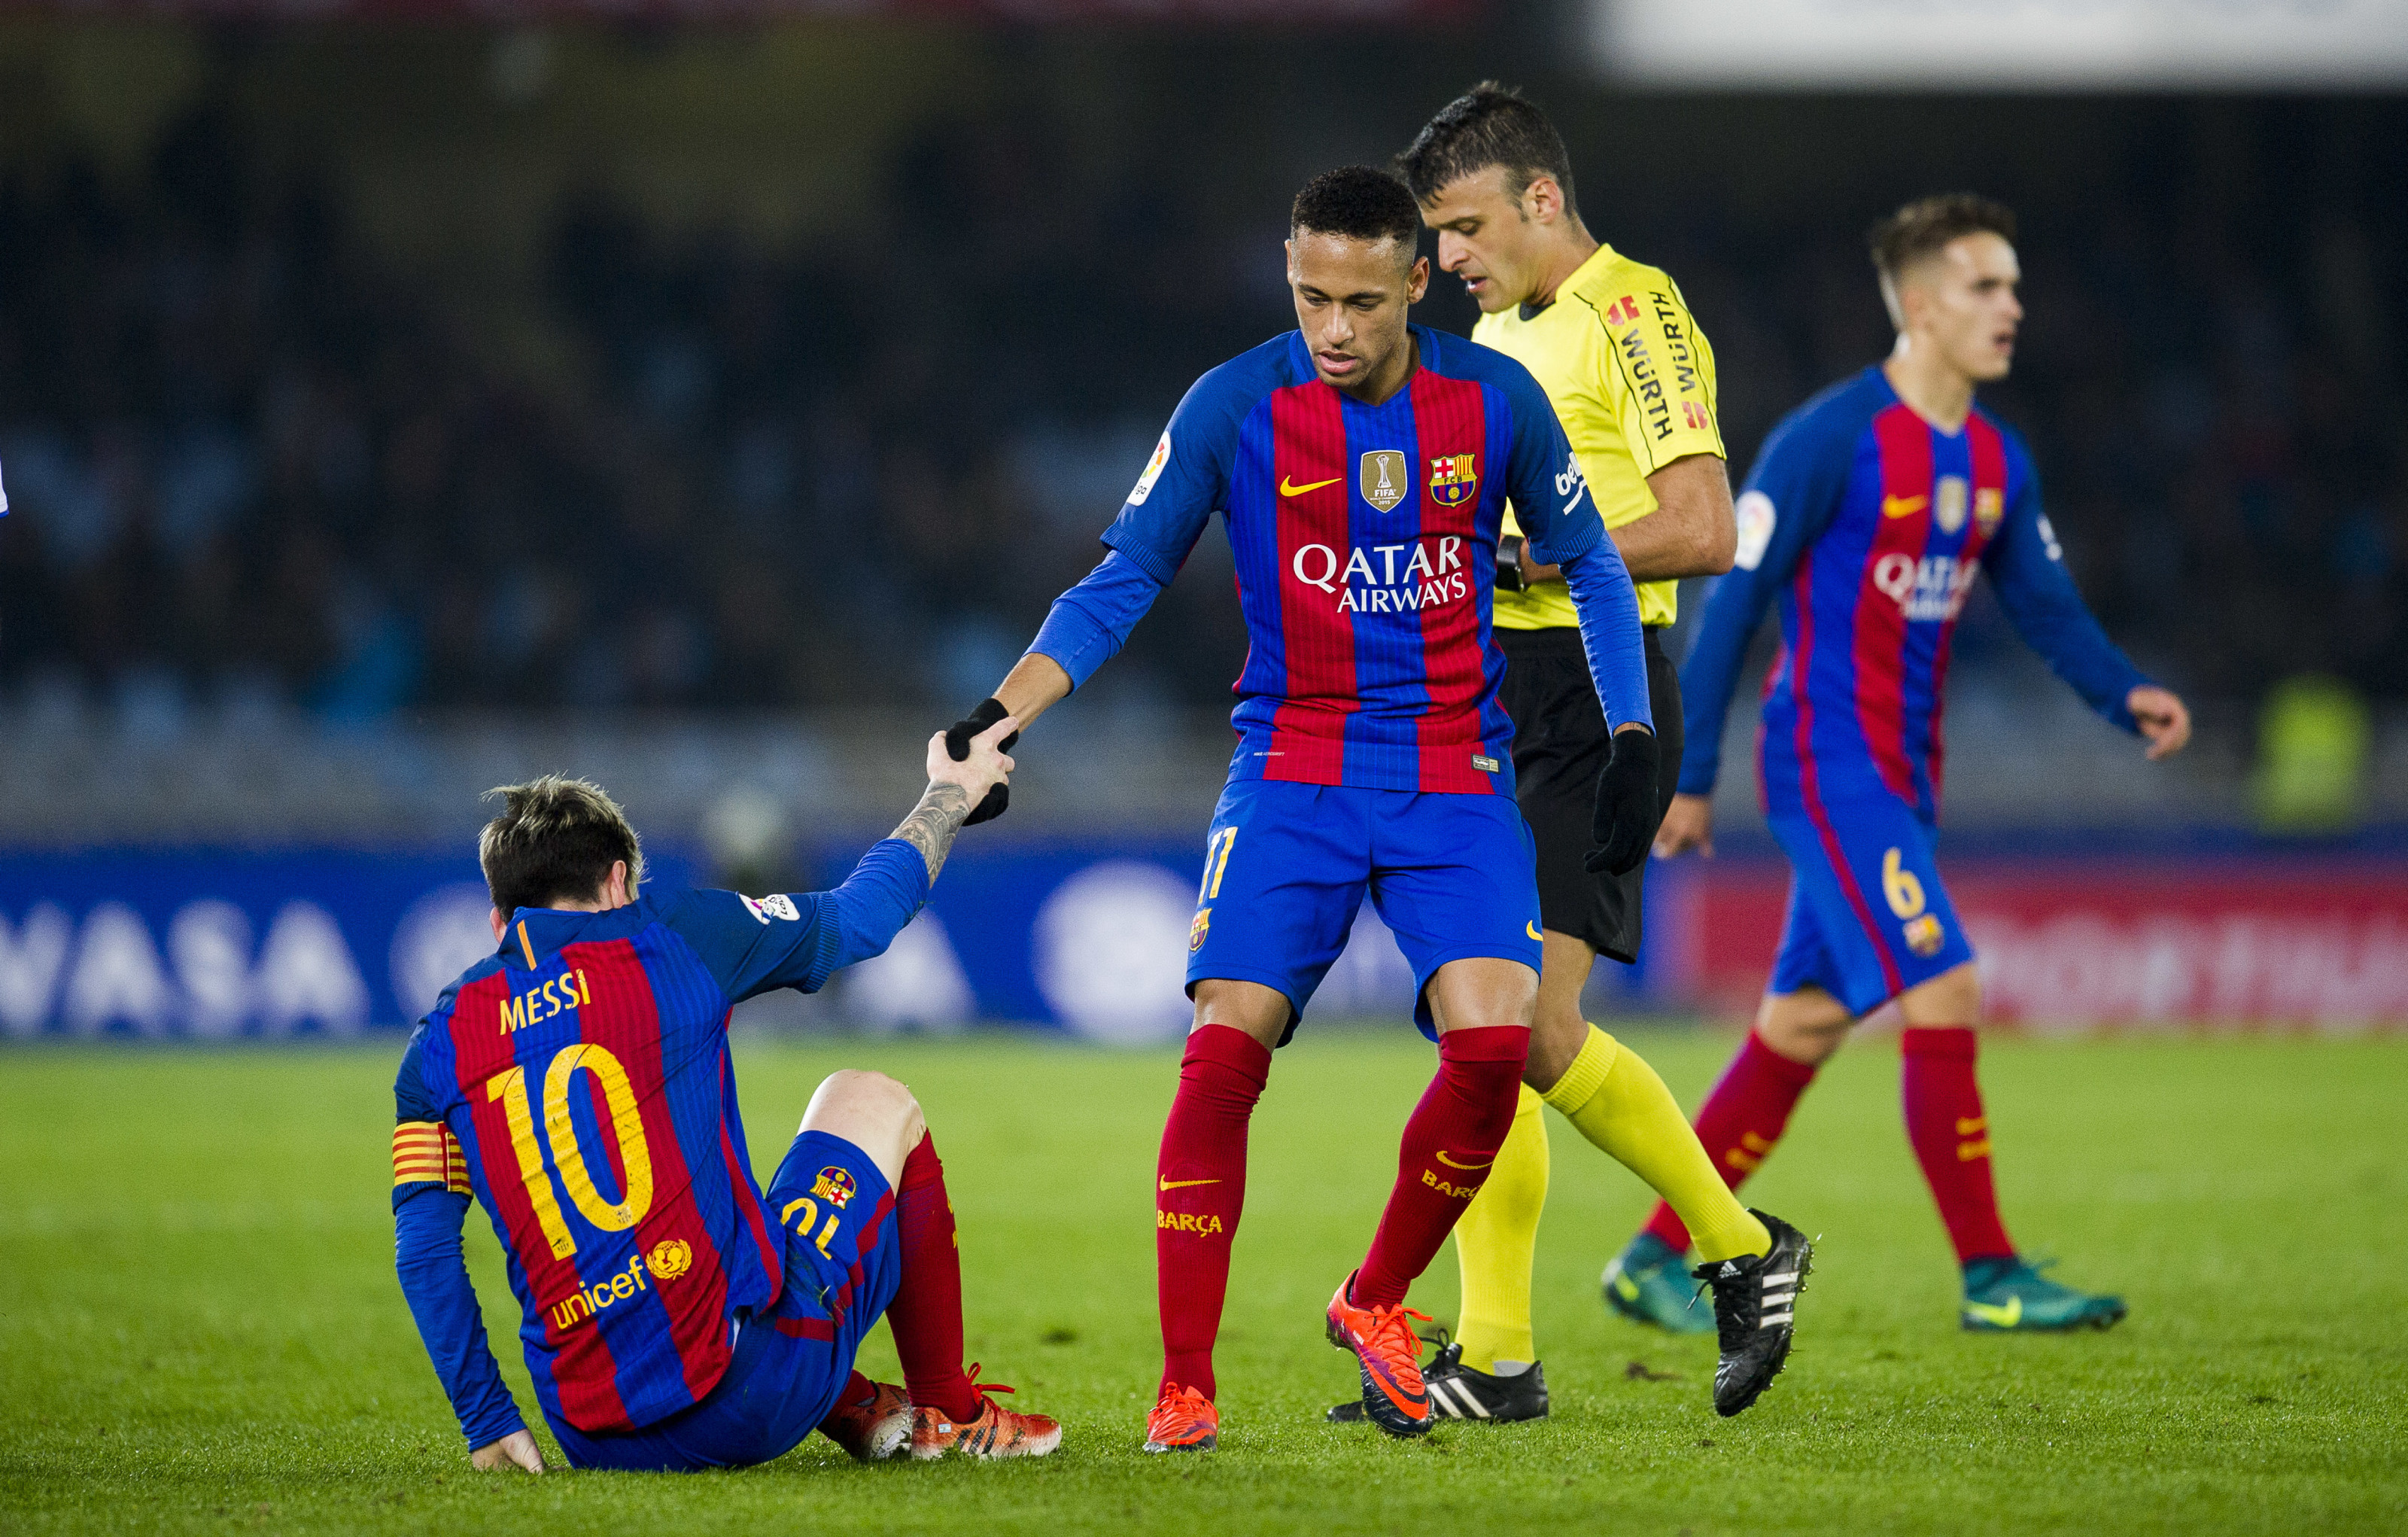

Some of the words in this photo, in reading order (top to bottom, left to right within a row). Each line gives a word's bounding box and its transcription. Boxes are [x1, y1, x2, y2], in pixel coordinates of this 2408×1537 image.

[1649, 291, 1696, 393] WÜRTH
[1621, 328, 1674, 441] WÜRTH
[1374, 488, 1395, 498] FIFA
[1443, 476, 1463, 484] FCB
[1293, 534, 1462, 594] QATAR
[1336, 572, 1467, 613] AIRWAYS
[1882, 846, 1926, 920] 6
[499, 968, 591, 1036] MESSI
[486, 1043, 654, 1262] 10
[1421, 1168, 1483, 1201] BARÇ
[1157, 1209, 1223, 1238] BARÇA
[552, 1254, 646, 1330] unicef
